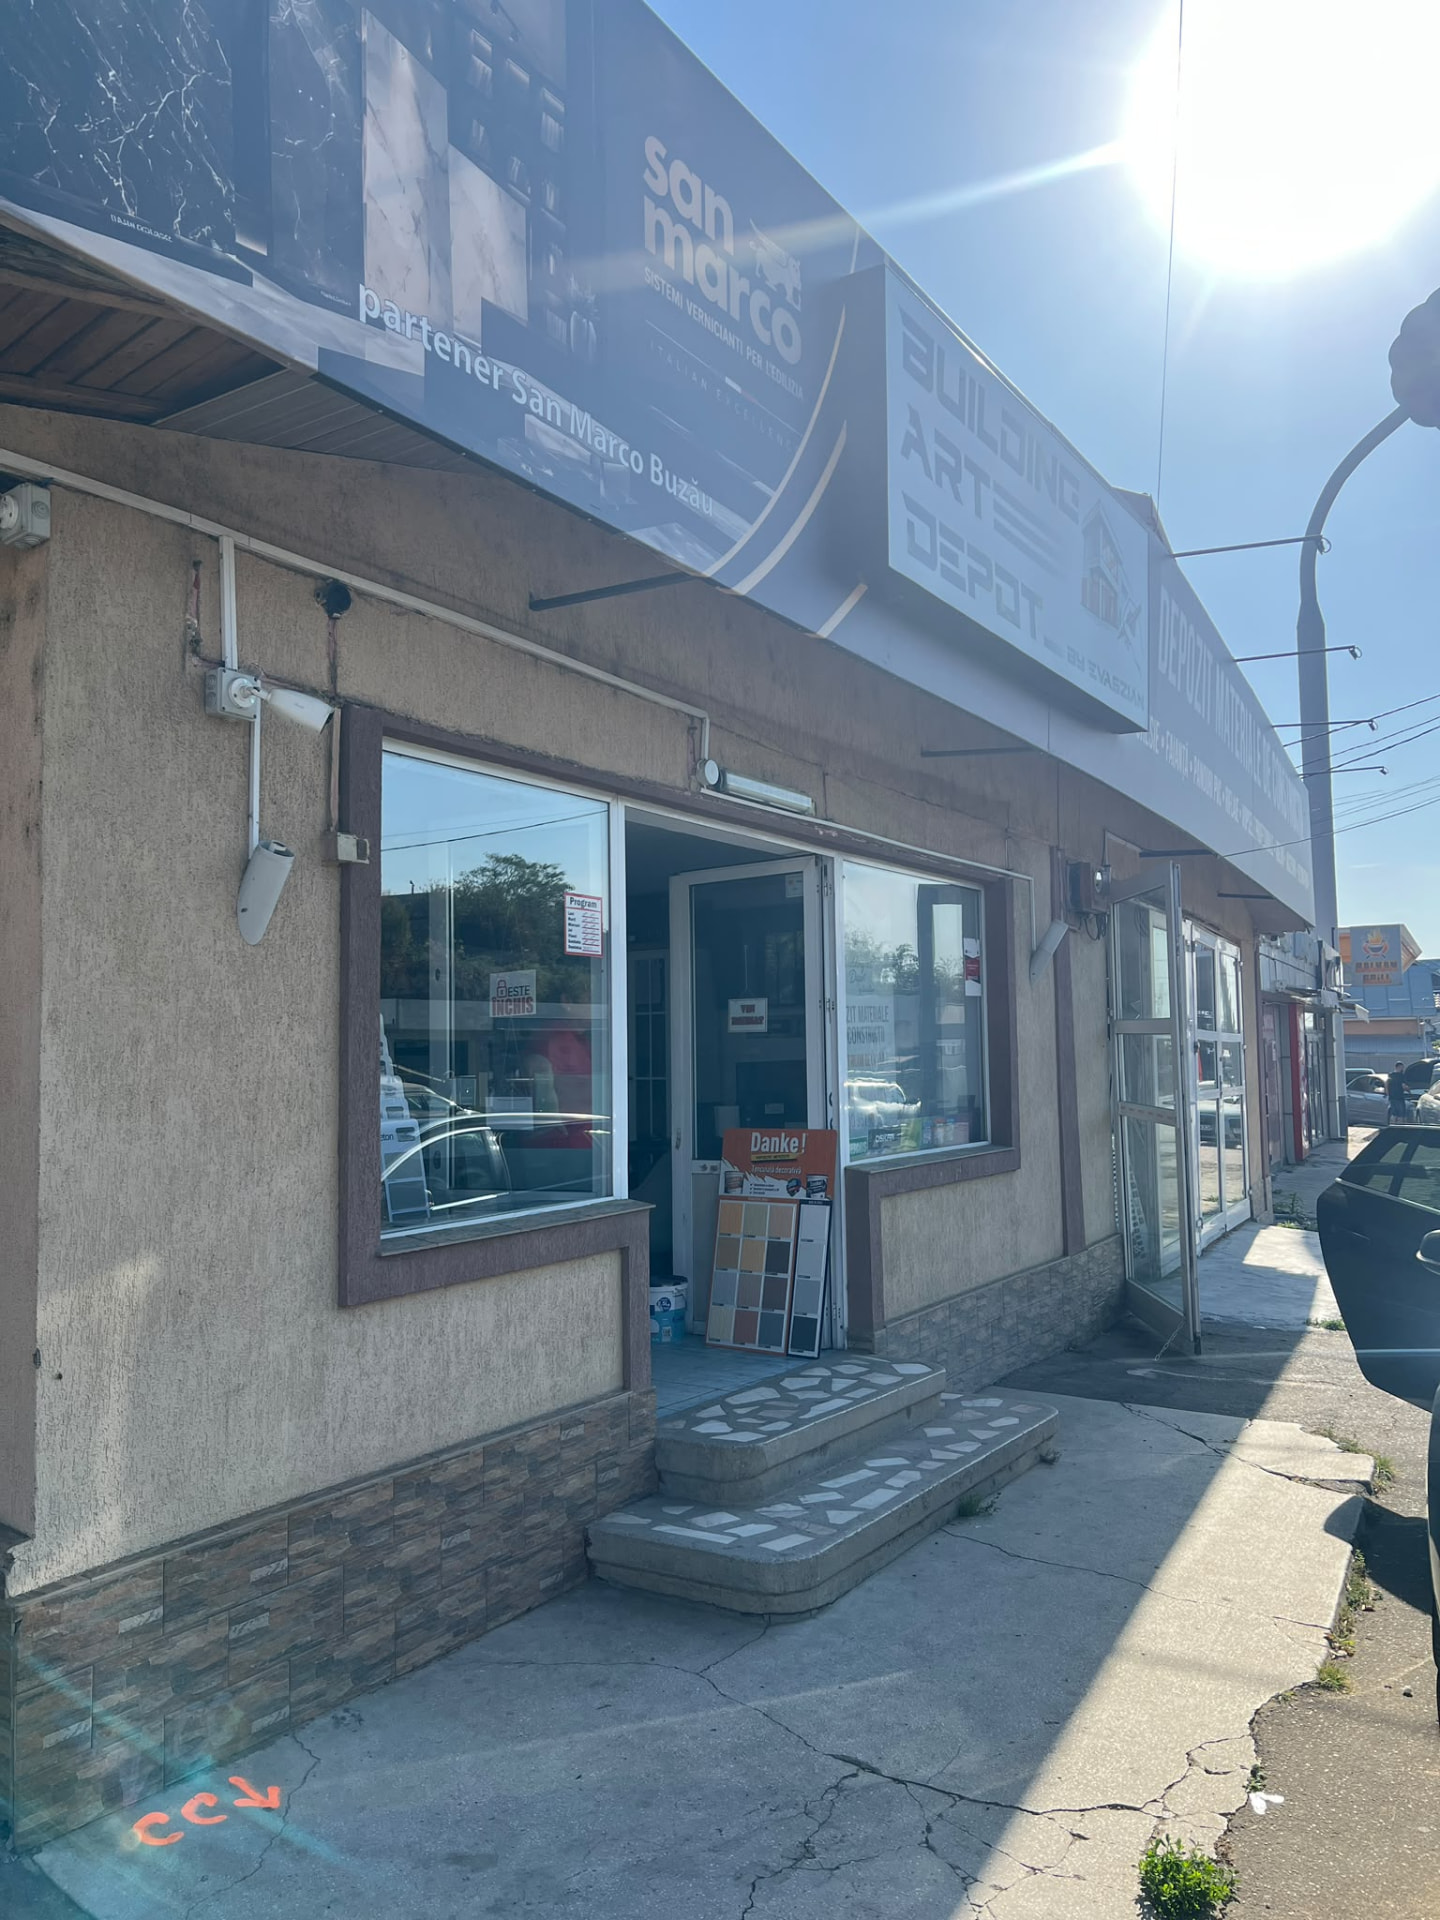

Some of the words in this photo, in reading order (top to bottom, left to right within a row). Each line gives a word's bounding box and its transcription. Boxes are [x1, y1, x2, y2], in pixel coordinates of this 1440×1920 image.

[643, 136, 734, 257] san
[643, 195, 802, 365] marco
[644, 266, 684, 311] SISTEMI
[686, 298, 744, 356] VERNICIANTI
[746, 345, 763, 370] PER
[359, 283, 504, 390] partener
[511, 369, 562, 428] San
[570, 402, 644, 475] Marco
[650, 452, 714, 517] Buzău
[899, 303, 1080, 526] BUILDING
[900, 402, 991, 521] ART
[902, 489, 1043, 641] DEPOT
[1157, 585, 1213, 725] DEPOZIT
[1215, 655, 1262, 789] MATERIALE
[569, 896, 598, 909] Program
[508, 985, 531, 997] ESTE
